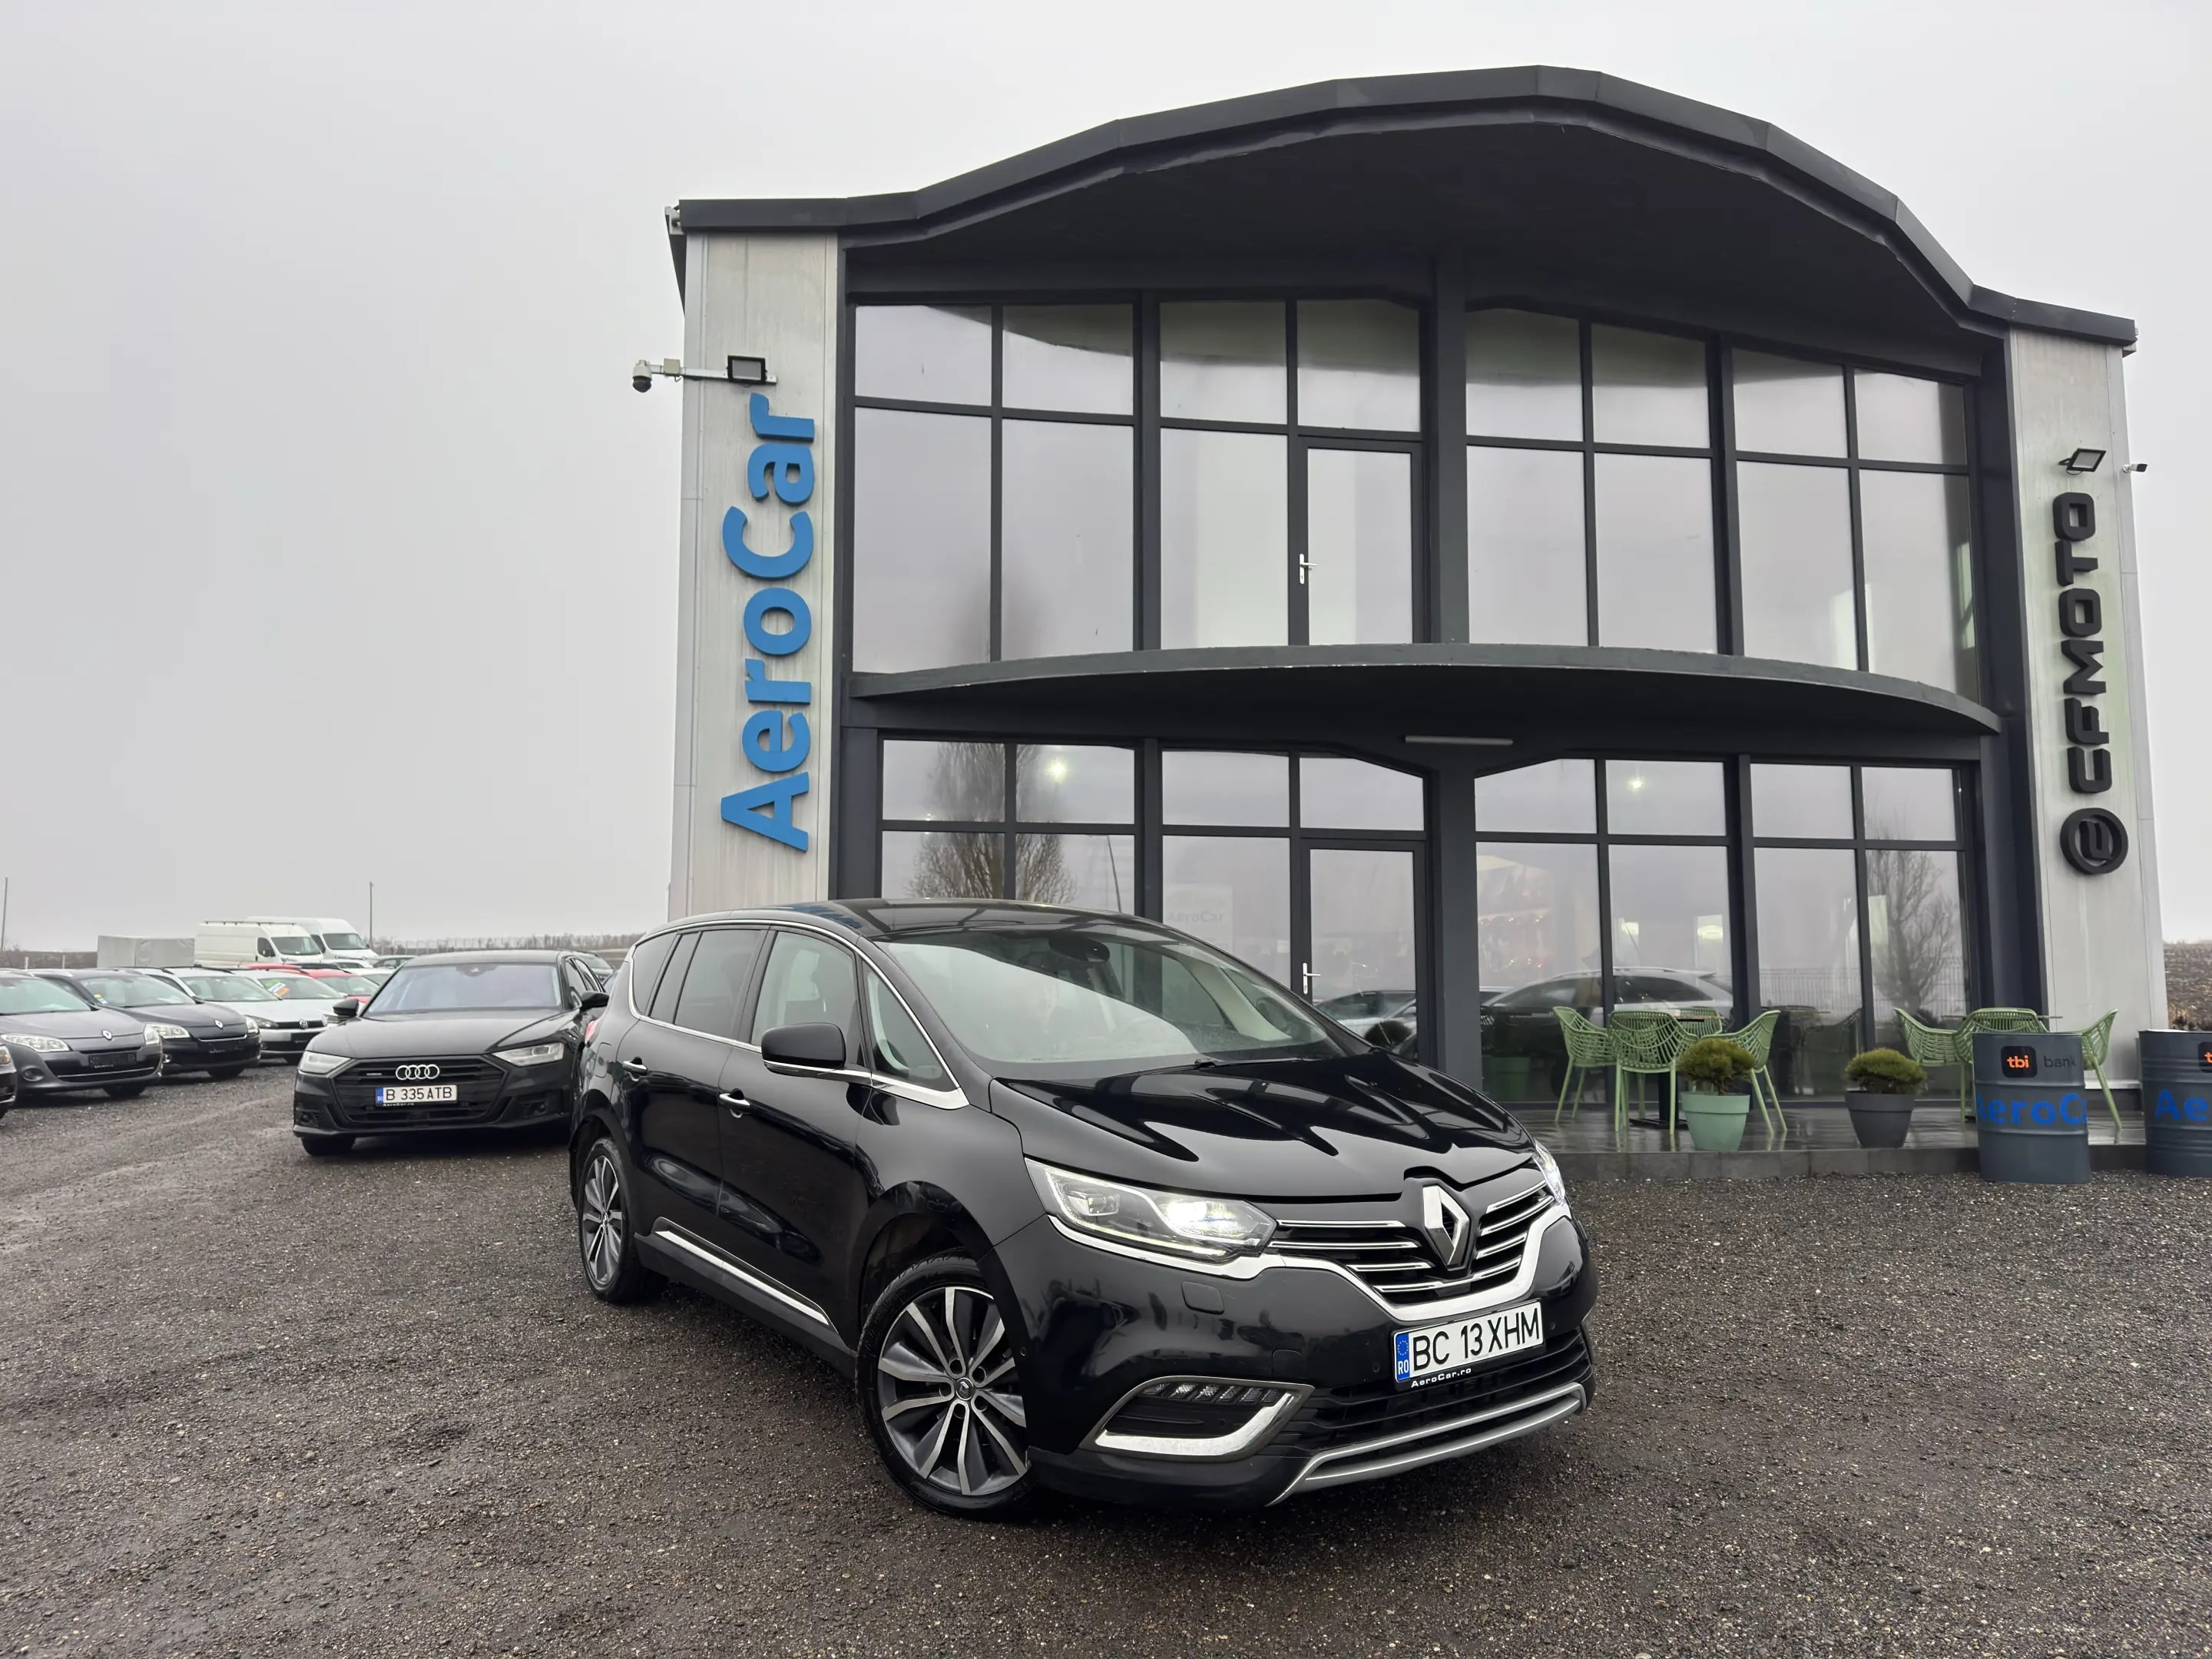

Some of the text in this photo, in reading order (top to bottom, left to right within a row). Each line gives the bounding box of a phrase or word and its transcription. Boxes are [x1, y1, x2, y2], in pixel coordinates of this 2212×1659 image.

[720, 392, 815, 853] AeroCar
[2053, 492, 2112, 793] CFMOTO
[2007, 1055, 2077, 1068] tbi bank
[386, 1087, 452, 1101] B 335 ATB
[1412, 1307, 1540, 1371] BC 13 XHM
[1398, 1359, 1409, 1375] RO
[1411, 1368, 1472, 1388] AeroCar.ro
